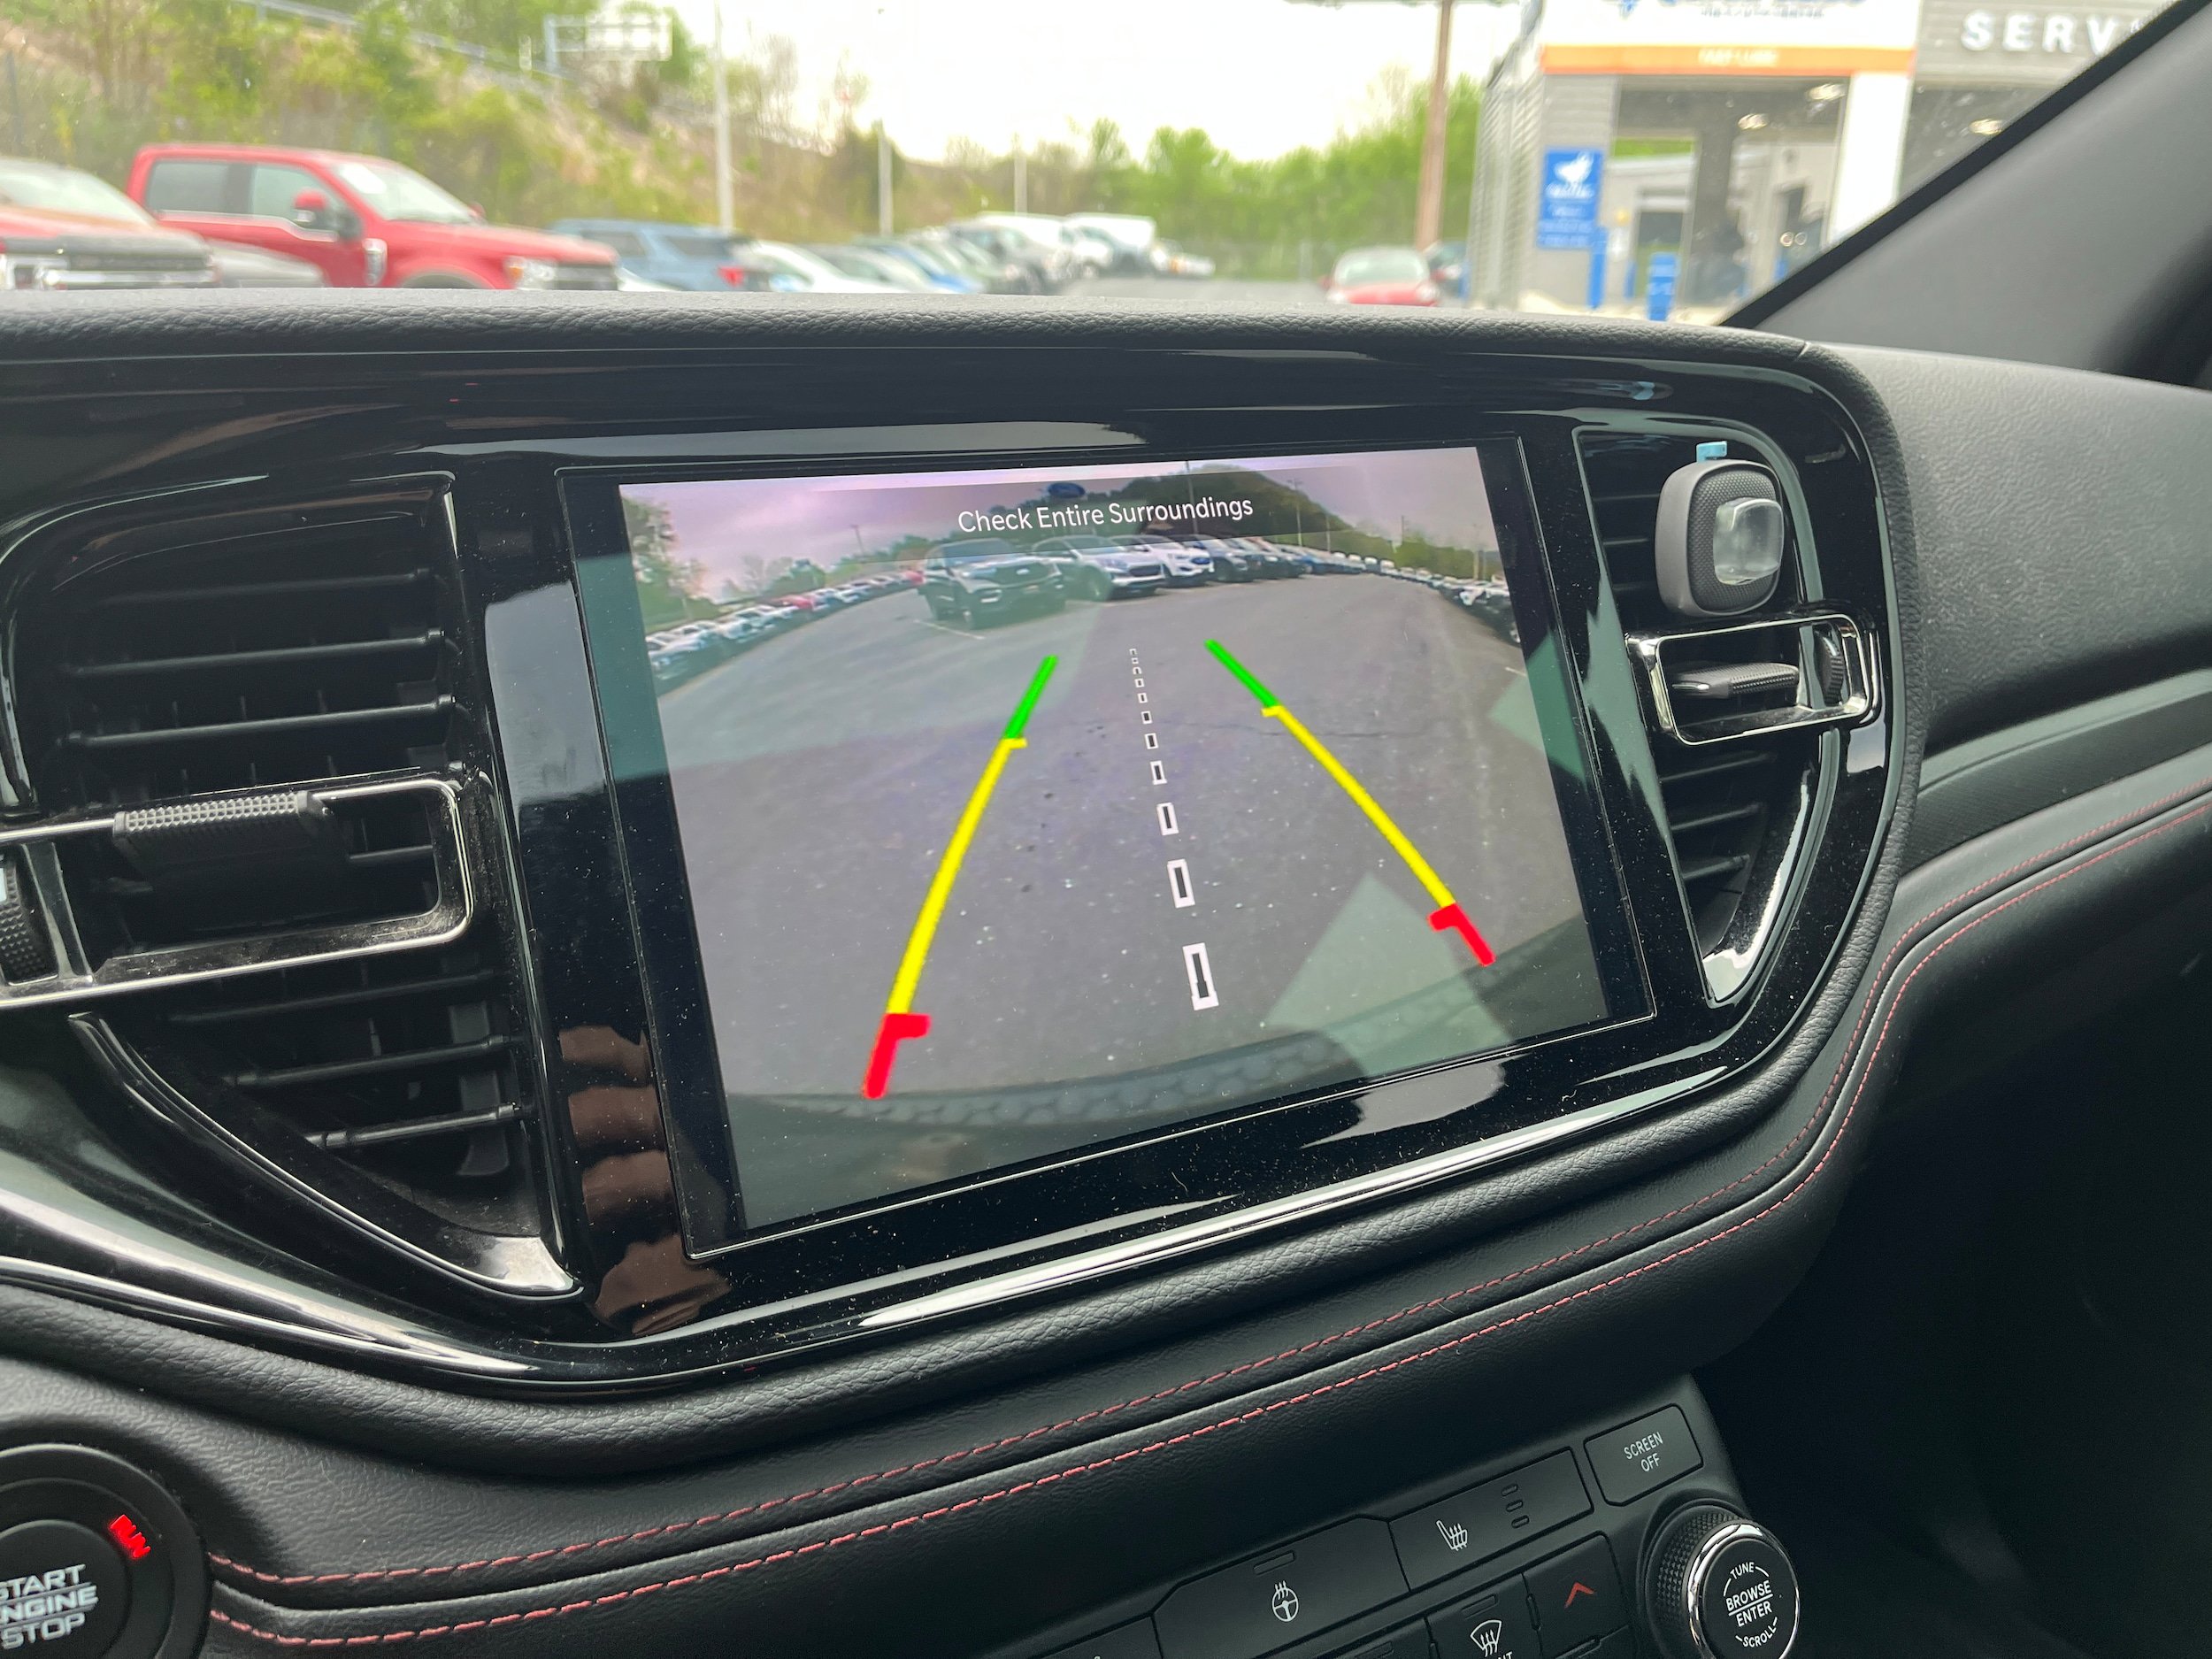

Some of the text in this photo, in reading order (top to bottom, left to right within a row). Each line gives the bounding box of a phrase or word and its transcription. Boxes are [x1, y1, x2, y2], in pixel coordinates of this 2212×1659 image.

[1960, 9, 2141, 56] SERV
[957, 496, 1254, 533] Check Entire Surroundings
[1624, 1431, 1663, 1460] SCREEN
[1640, 1452, 1660, 1472] OFF
[1730, 1562, 1755, 1579] TUNE
[0, 1585, 99, 1624] NGINE
[1725, 1580, 1772, 1611] BROWSE
[1736, 1601, 1772, 1627] ENTER
[1, 1612, 86, 1650] STOP
[1742, 1624, 1777, 1647] SCROLL
